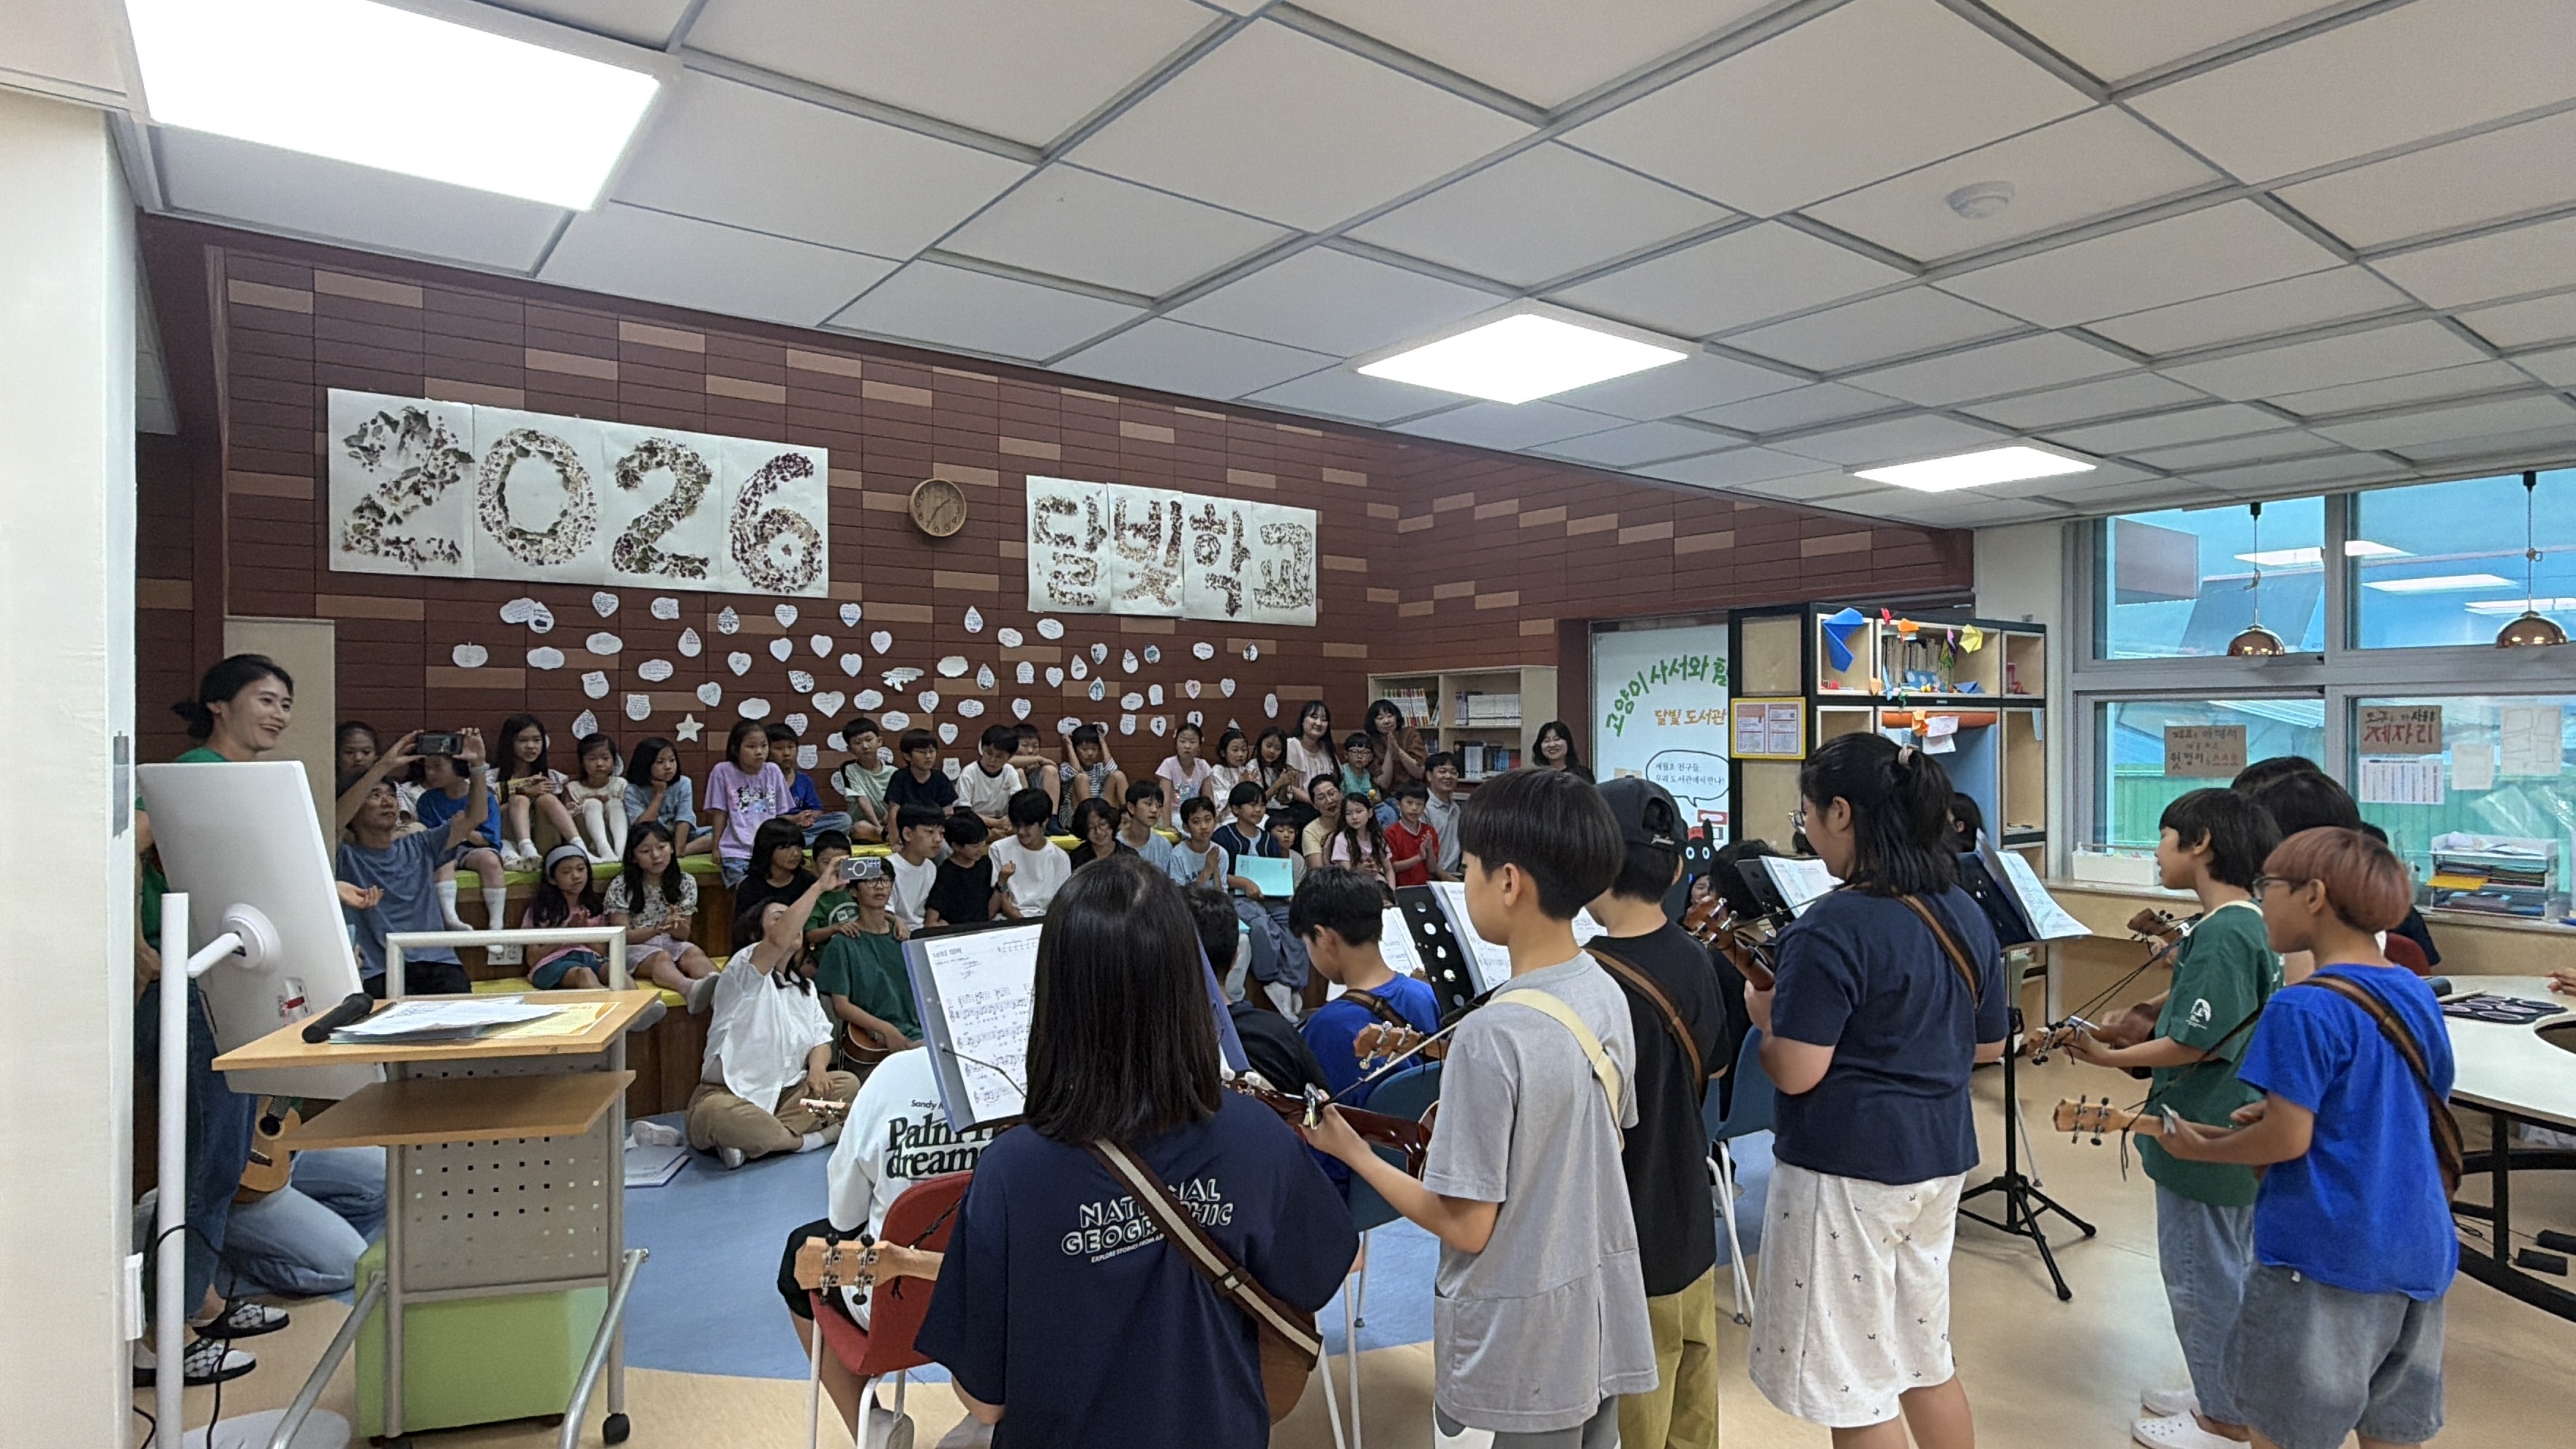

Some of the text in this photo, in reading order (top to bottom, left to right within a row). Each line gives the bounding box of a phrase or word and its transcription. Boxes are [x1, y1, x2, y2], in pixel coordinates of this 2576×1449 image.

[342, 405, 824, 594] 2026
[1033, 488, 1314, 617] 달빛학교
[1606, 670, 1650, 738] 고양이
[1650, 654, 1710, 685] 사서와
[1684, 708, 1727, 726] 도서관
[2363, 723, 2433, 745] 제자리
[910, 1099, 937, 1111] Sandy
[1061, 1201, 1234, 1256] GEOGRHIC
[1079, 1177, 1221, 1229] NATNAL
[1090, 1251, 1116, 1263] EXPLORE
[1139, 1237, 1156, 1248] FROM
